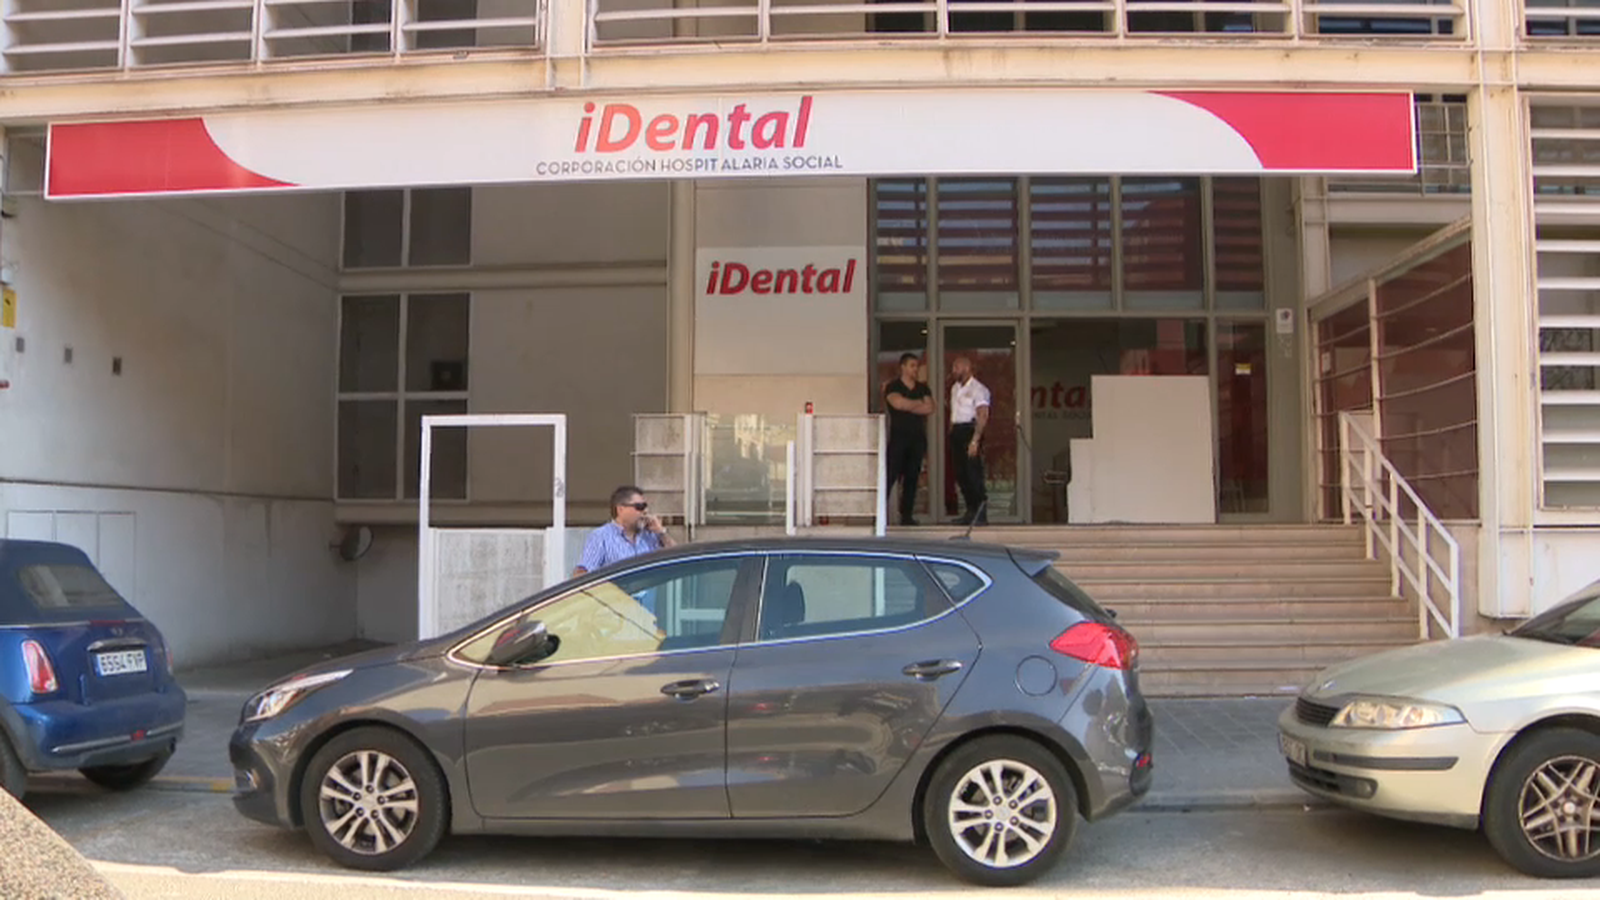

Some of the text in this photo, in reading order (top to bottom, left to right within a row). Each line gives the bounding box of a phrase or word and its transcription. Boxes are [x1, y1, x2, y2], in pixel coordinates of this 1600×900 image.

[575, 95, 813, 153] iDental
[536, 156, 656, 175] CORPORACIÓN
[783, 155, 844, 170] SOCIAL
[706, 258, 857, 295] iDental
